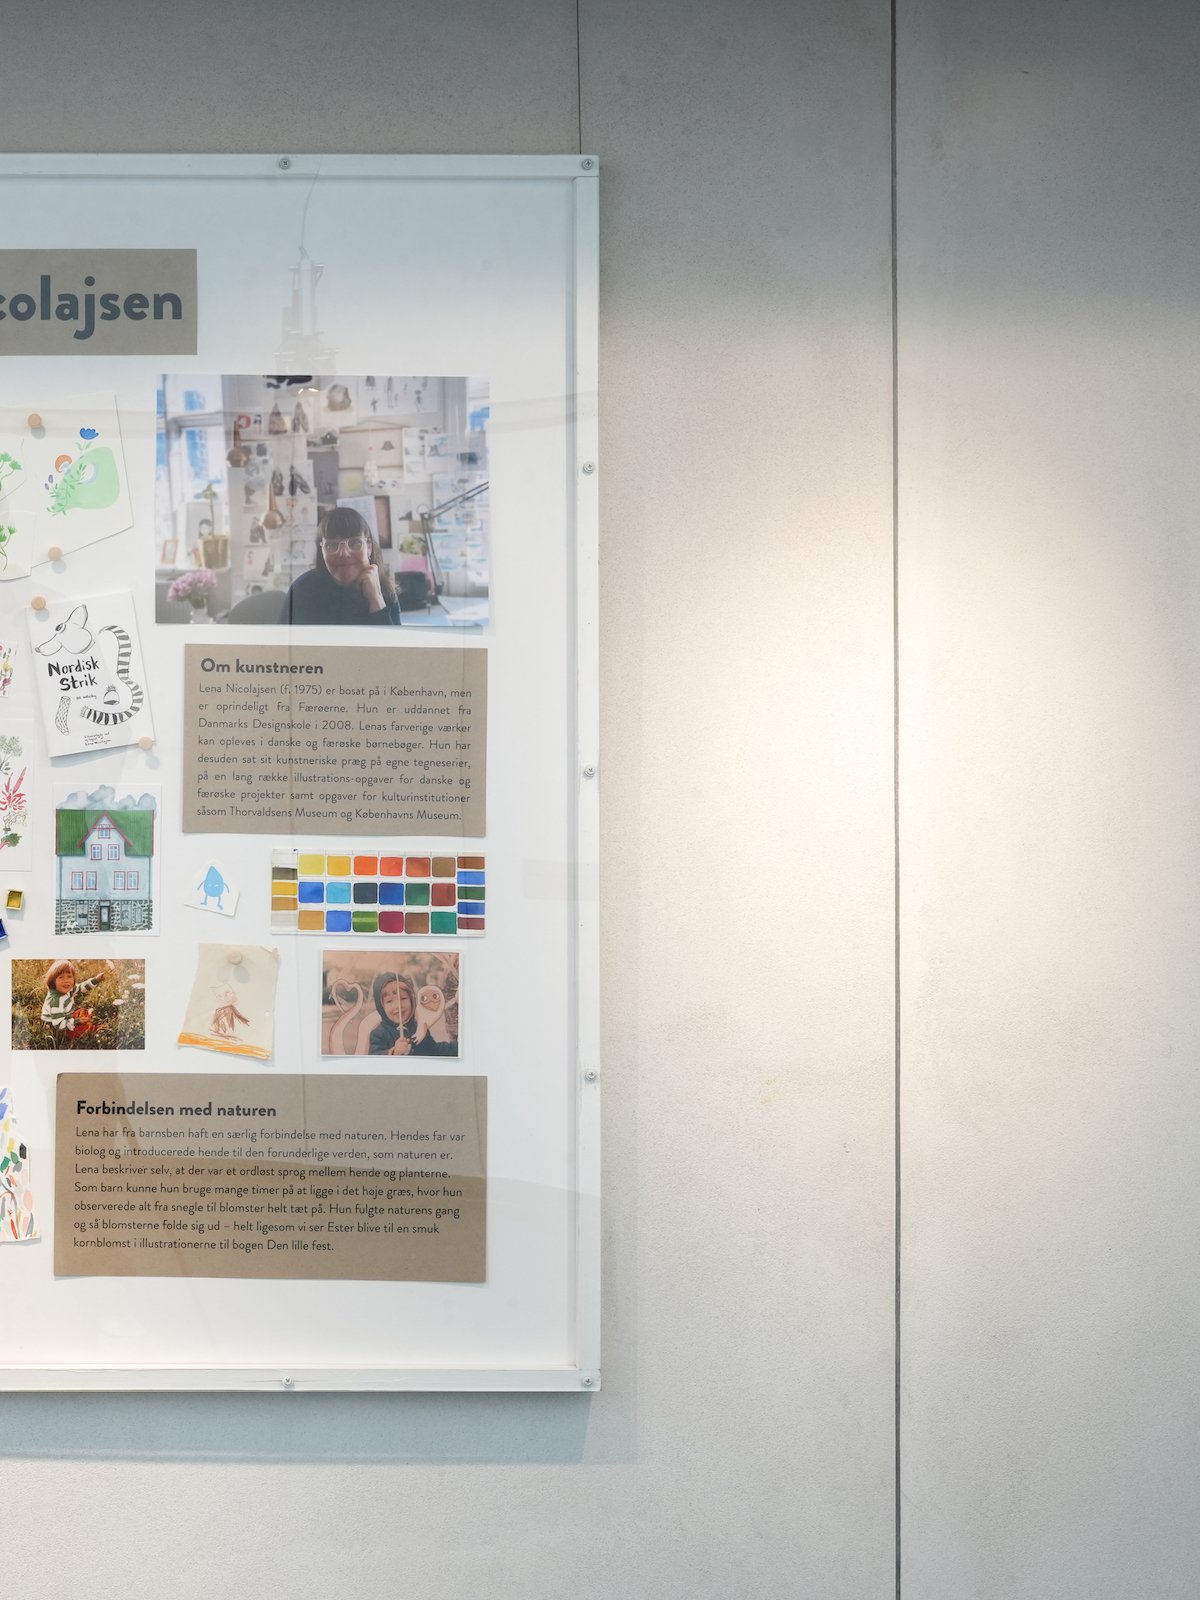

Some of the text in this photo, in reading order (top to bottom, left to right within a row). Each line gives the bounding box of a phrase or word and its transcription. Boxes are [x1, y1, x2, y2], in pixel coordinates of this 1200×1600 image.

[48, 655, 100, 677] Nordisk
[200, 659, 323, 674] Om kunstneren
[59, 673, 98, 691] Strik
[198, 718, 248, 728] Danmarks
[252, 719, 311, 732] Designskole
[321, 720, 353, 730] 2008.
[359, 721, 386, 731] Lenas
[390, 721, 433, 734] farverige
[437, 722, 471, 732] værker
[197, 753, 470, 770] desuden sat sit kunstneriske præg på egne tegneserier,
[197, 789, 470, 804] færøske projekter samt opgaver for kulturinstitutioner
[196, 807, 461, 822] såsom Thorvaldsens Museum og Københavns Museum.
[77, 1100, 276, 1117] Forbindelsen med naturen
[75, 1146, 452, 1161] biolog og introducerede hende til den forunderlige verden, som naturen er.
[75, 1164, 450, 1181] Lena beskriver selv, at der var et ordløst sprog mellem hende og planterne.
